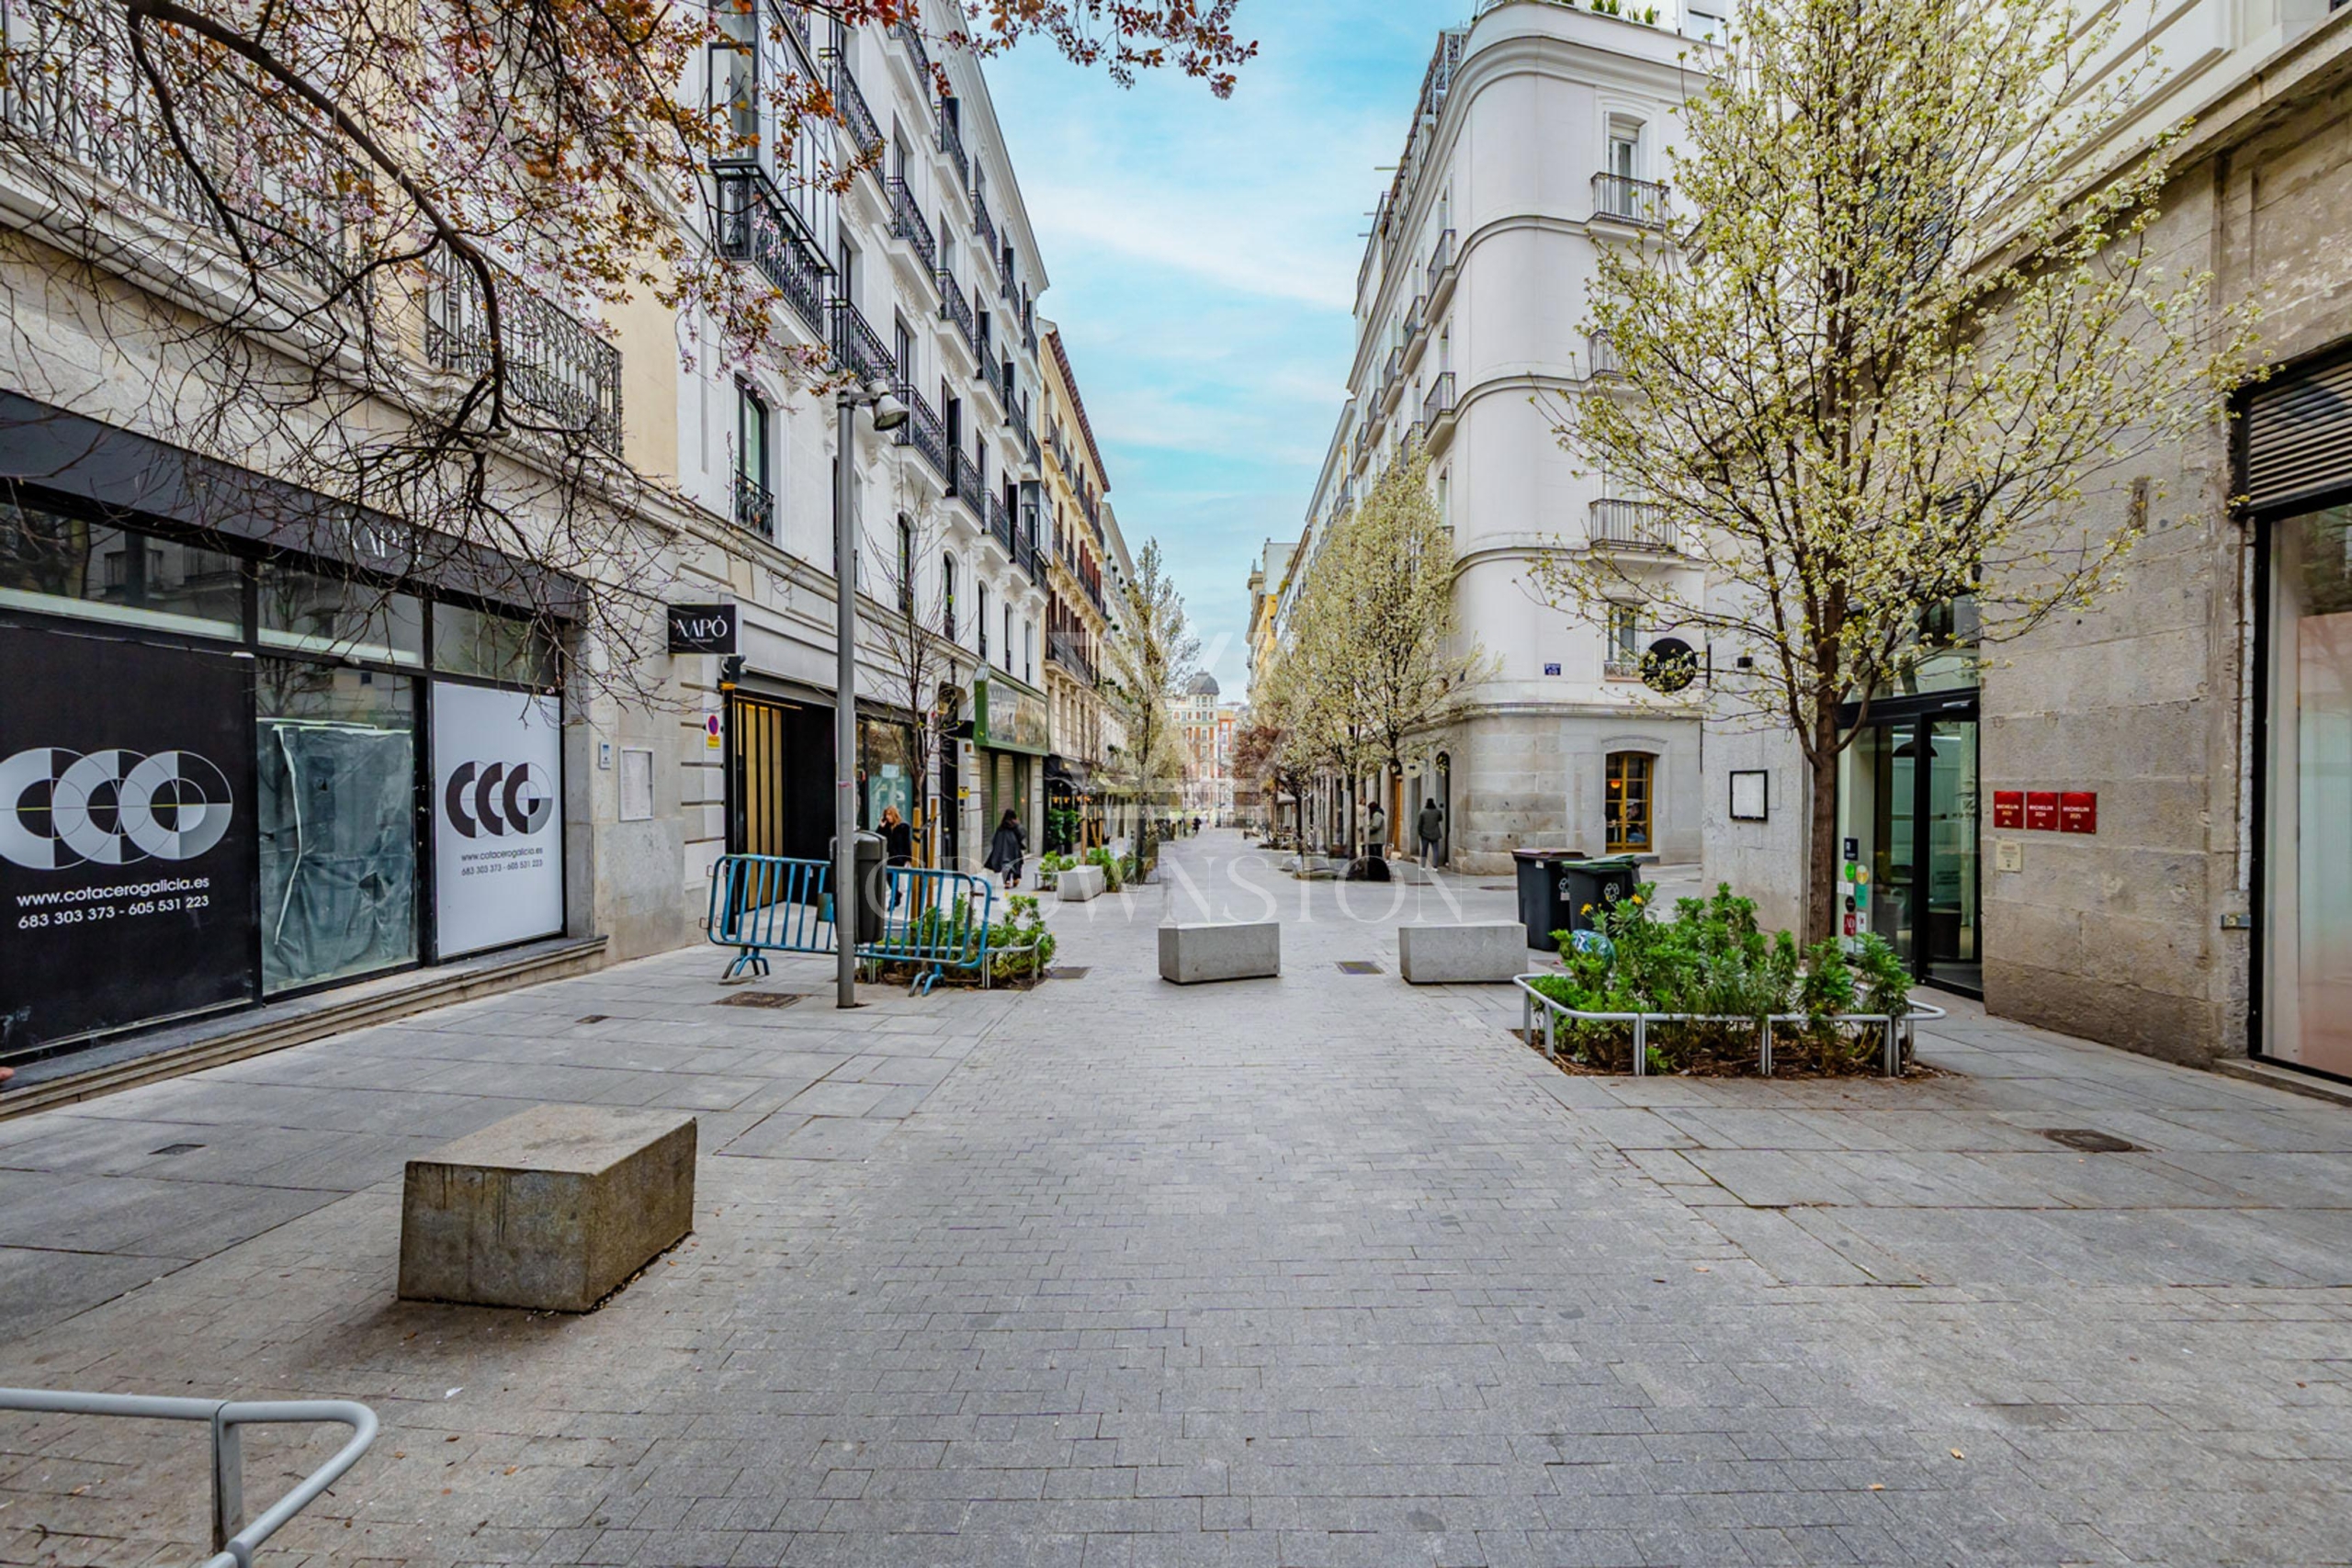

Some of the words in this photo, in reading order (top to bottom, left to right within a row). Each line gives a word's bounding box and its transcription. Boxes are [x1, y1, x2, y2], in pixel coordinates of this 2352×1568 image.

[461, 847, 543, 861] www.cotacerogalicia.es
[17, 877, 209, 908] www.cotacerogalicia.es
[18, 913, 50, 930] 683
[53, 909, 84, 926] 303
[87, 906, 116, 920] 373
[129, 902, 154, 916] 605
[158, 898, 181, 912] 531
[186, 895, 209, 908] 223
